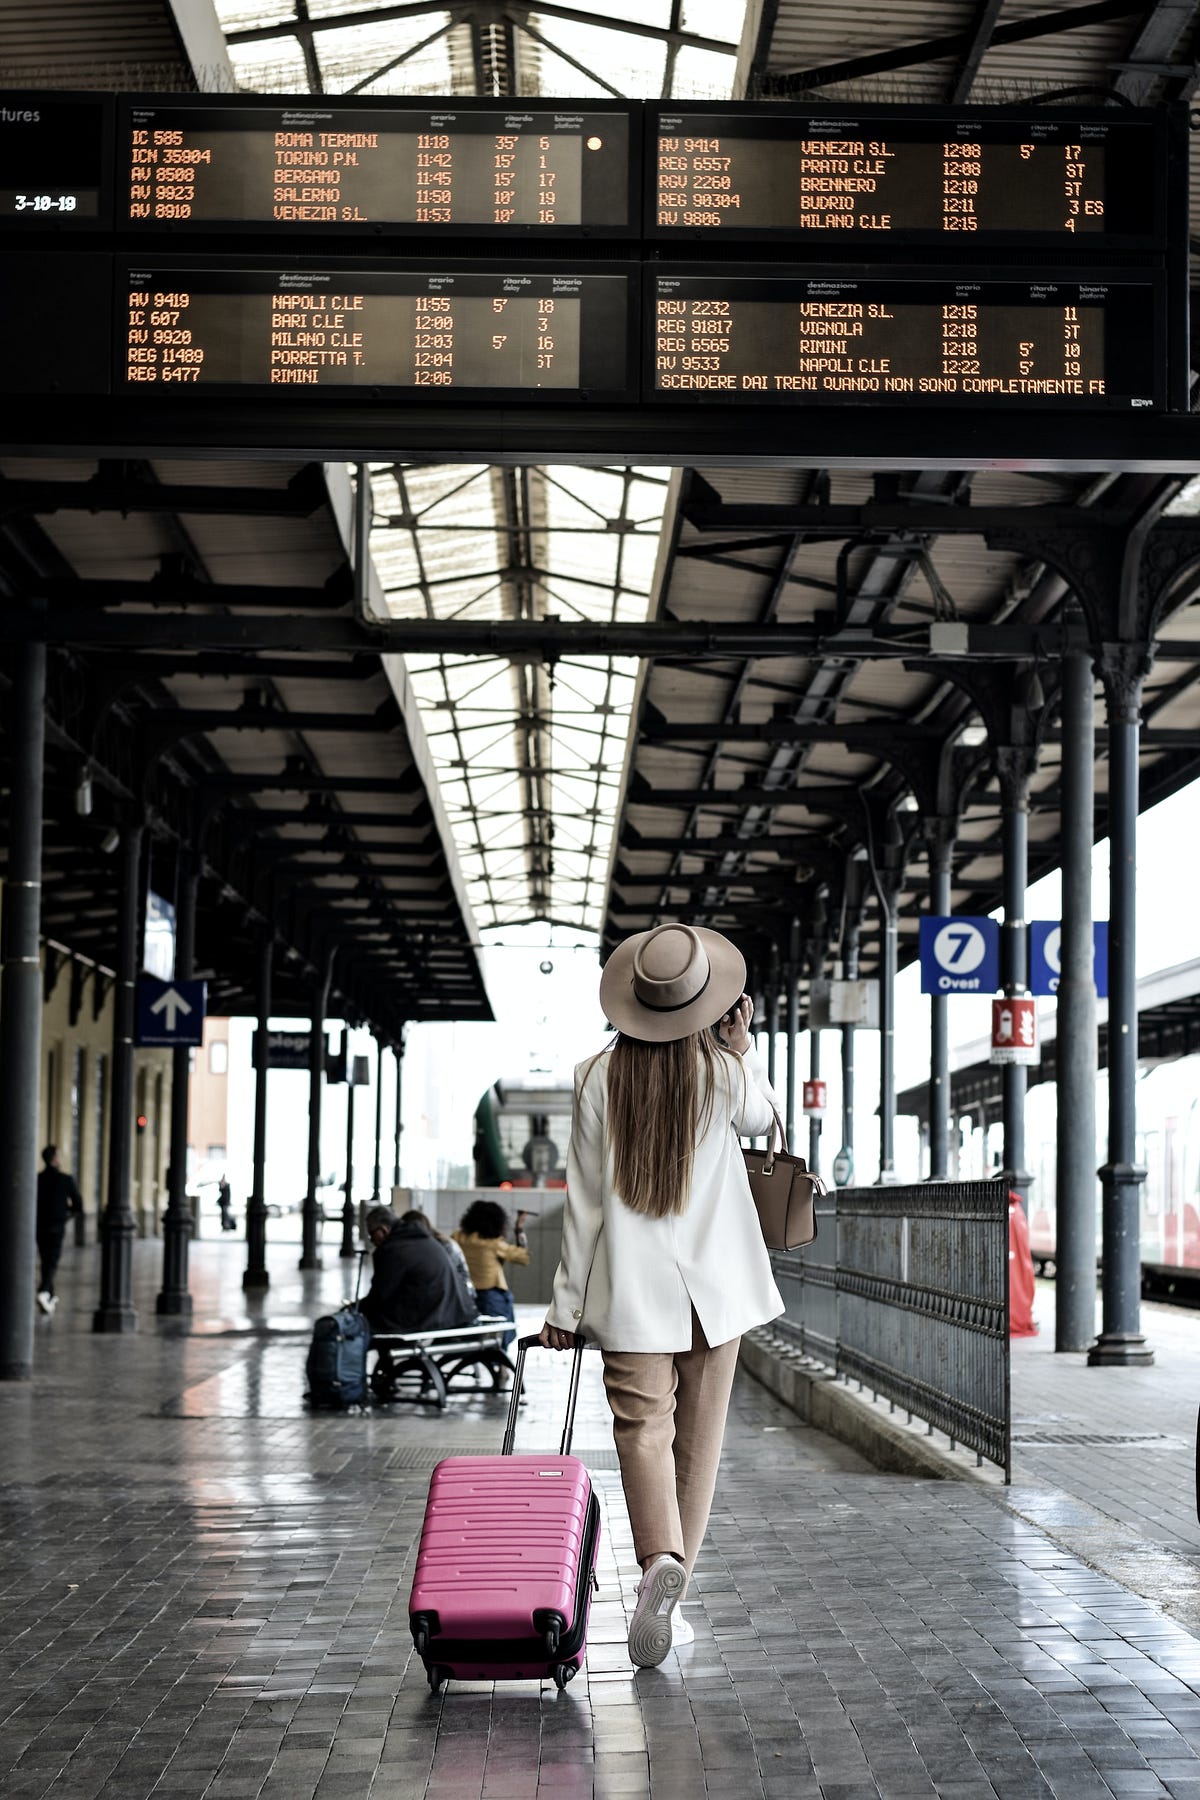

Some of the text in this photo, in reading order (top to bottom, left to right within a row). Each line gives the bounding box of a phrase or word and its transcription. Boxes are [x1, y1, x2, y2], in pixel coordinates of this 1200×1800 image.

[0, 107, 40, 122] tures
[133, 131, 549, 150] IC 585 ROMA TERMINI 11:18 35' 6
[660, 138, 679, 151] AV
[684, 139, 719, 152] 9414
[801, 141, 864, 155] VENEZIA
[869, 142, 895, 156] S.L.
[1021, 145, 1034, 159] 5'
[1065, 146, 1081, 159] 17
[132, 149, 157, 163] ICN
[275, 151, 328, 165] TORINO
[334, 152, 358, 165] P.N.
[418, 154, 452, 167] 11:42
[495, 155, 515, 167] 15'
[540, 155, 546, 168] 1
[659, 157, 687, 170] REG
[693, 157, 731, 171] 6557
[801, 159, 848, 173] PRATO
[854, 160, 885, 174] C.LE
[1067, 164, 1085, 178] ST
[131, 167, 151, 181] AV
[275, 170, 340, 183] BERGAMO
[417, 172, 451, 185] 11:45
[495, 173, 515, 186] 15'
[540, 174, 555, 186] 17
[659, 175, 687, 188] RGV
[693, 176, 731, 189] 2260
[801, 178, 876, 192] BRENNERO
[943, 180, 977, 194] 12:10
[131, 185, 150, 199] AV
[274, 188, 340, 202] SALERNO
[417, 190, 451, 203] 11:50
[494, 191, 515, 204] 10'
[539, 192, 555, 204] 19
[659, 193, 687, 206] REG
[801, 196, 854, 210] BUDRIO
[943, 198, 974, 212] 12:11
[1070, 200, 1079, 214] 3
[1085, 201, 1103, 215] ES
[131, 204, 150, 217] AV
[274, 206, 336, 220] VENEZIA
[342, 207, 367, 220] S.L.
[416, 208, 451, 221] 11:53
[494, 209, 515, 222] 10'
[539, 210, 555, 223] 16
[659, 211, 677, 224] AV
[801, 214, 854, 228] MILANO
[860, 215, 891, 229] C.LE
[943, 217, 977, 230] 12:15
[1065, 219, 1074, 232] 4
[280, 274, 330, 282] destinazione
[807, 282, 858, 290] destinazione
[129, 293, 149, 307] AV
[273, 296, 326, 309] NAPOLI
[332, 296, 363, 310] C.LE
[416, 298, 450, 311] 11:55
[493, 299, 507, 312] 5'
[538, 300, 554, 313] 18
[658, 301, 1077, 320] RGV 2232 VENEZIA S.L. 12:15 11
[129, 311, 547, 331] IC 607 BARI C.LE 12:00 3
[658, 320, 685, 333] REG
[692, 320, 732, 333] 91817
[800, 322, 862, 336] VIGNOLA
[943, 324, 976, 337] 12:18
[129, 330, 148, 343] AV
[272, 332, 325, 346] MILANO
[331, 333, 362, 347] C.LE
[415, 335, 452, 348] 12:03
[493, 336, 507, 349] 5'
[538, 336, 553, 349] 16
[658, 338, 1080, 357] REG 6565 RIMINI 12:18 5' 10
[128, 348, 157, 362] REG
[272, 351, 346, 365] PORRETTA
[353, 352, 365, 365] T.
[415, 353, 452, 366] 12:04
[657, 356, 1080, 375] AV 9533 NAPOLI C.LE 12:22 5' 19
[128, 367, 156, 381] REG
[162, 367, 200, 381] 6477
[271, 369, 318, 383] RIMINI
[662, 375, 736, 388] SCENDERE
[743, 376, 768, 389] DAI
[774, 376, 817, 390] TRENI
[823, 377, 879, 391] QUANDO
[885, 378, 913, 391] NON
[919, 378, 956, 392] SONO
[963, 379, 1083, 394] COMPLETAMENTE
[949, 934, 972, 963] 7
[938, 976, 980, 989] Ovest
